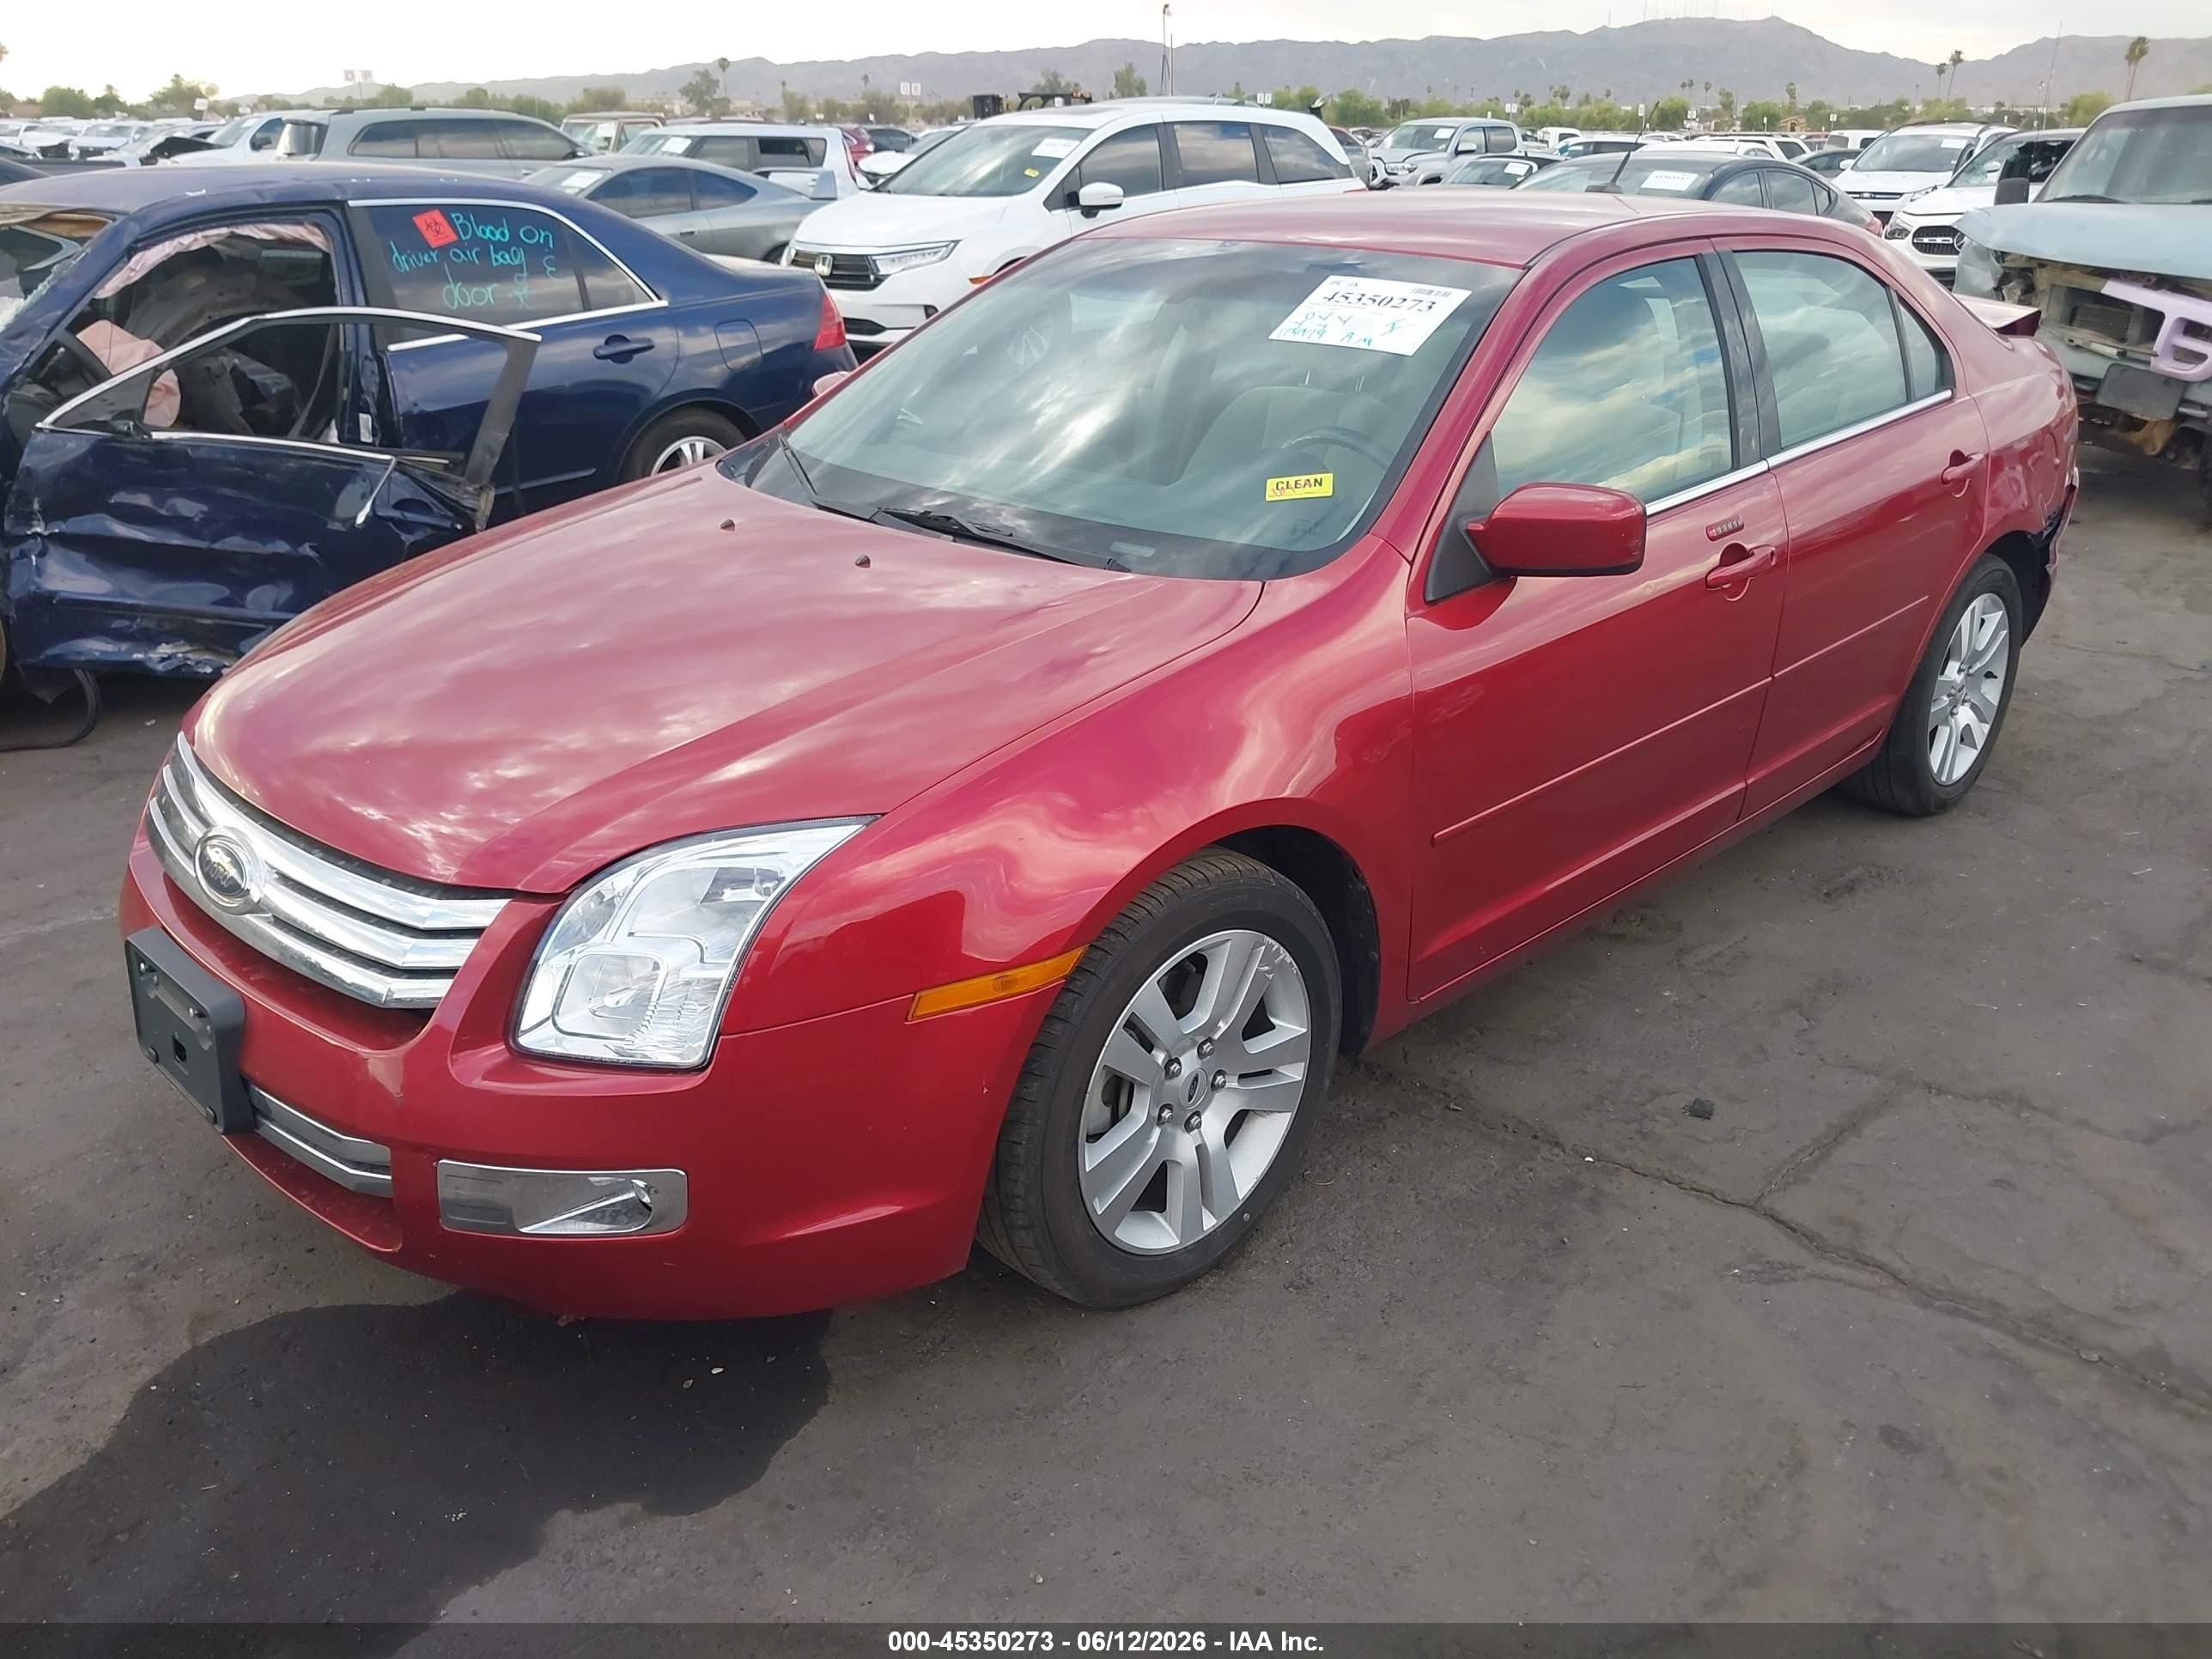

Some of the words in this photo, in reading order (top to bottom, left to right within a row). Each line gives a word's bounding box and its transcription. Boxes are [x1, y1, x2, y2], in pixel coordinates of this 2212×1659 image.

[451, 212, 510, 242] Blood
[390, 240, 439, 273] driver
[449, 243, 480, 266] air
[442, 262, 501, 310] door
[1323, 291, 1437, 312] 45350273
[1276, 477, 1323, 491] CLEAN
